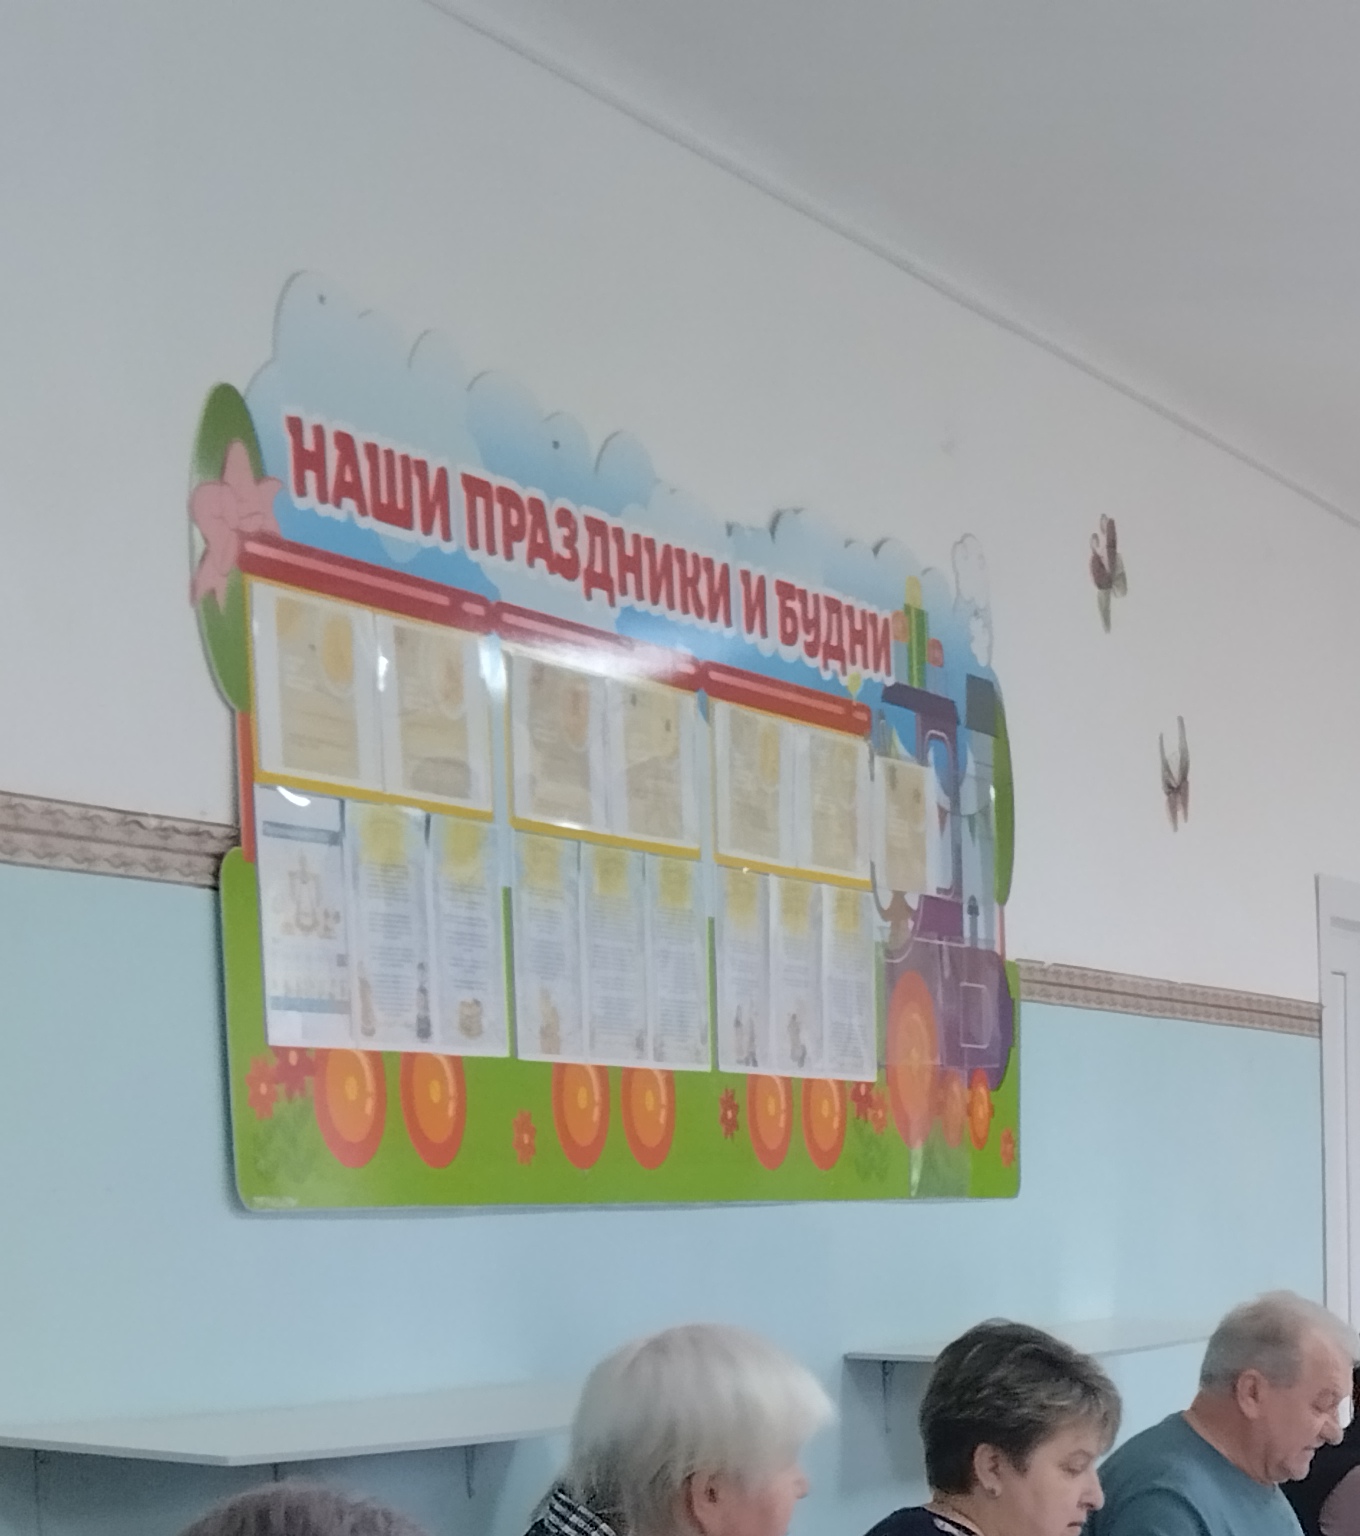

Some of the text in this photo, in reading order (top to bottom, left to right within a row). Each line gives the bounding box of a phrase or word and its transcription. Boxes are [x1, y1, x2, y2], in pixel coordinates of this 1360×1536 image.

[285, 414, 894, 678] НАШИ ПРАЗДНИКИ И БУДНИ
